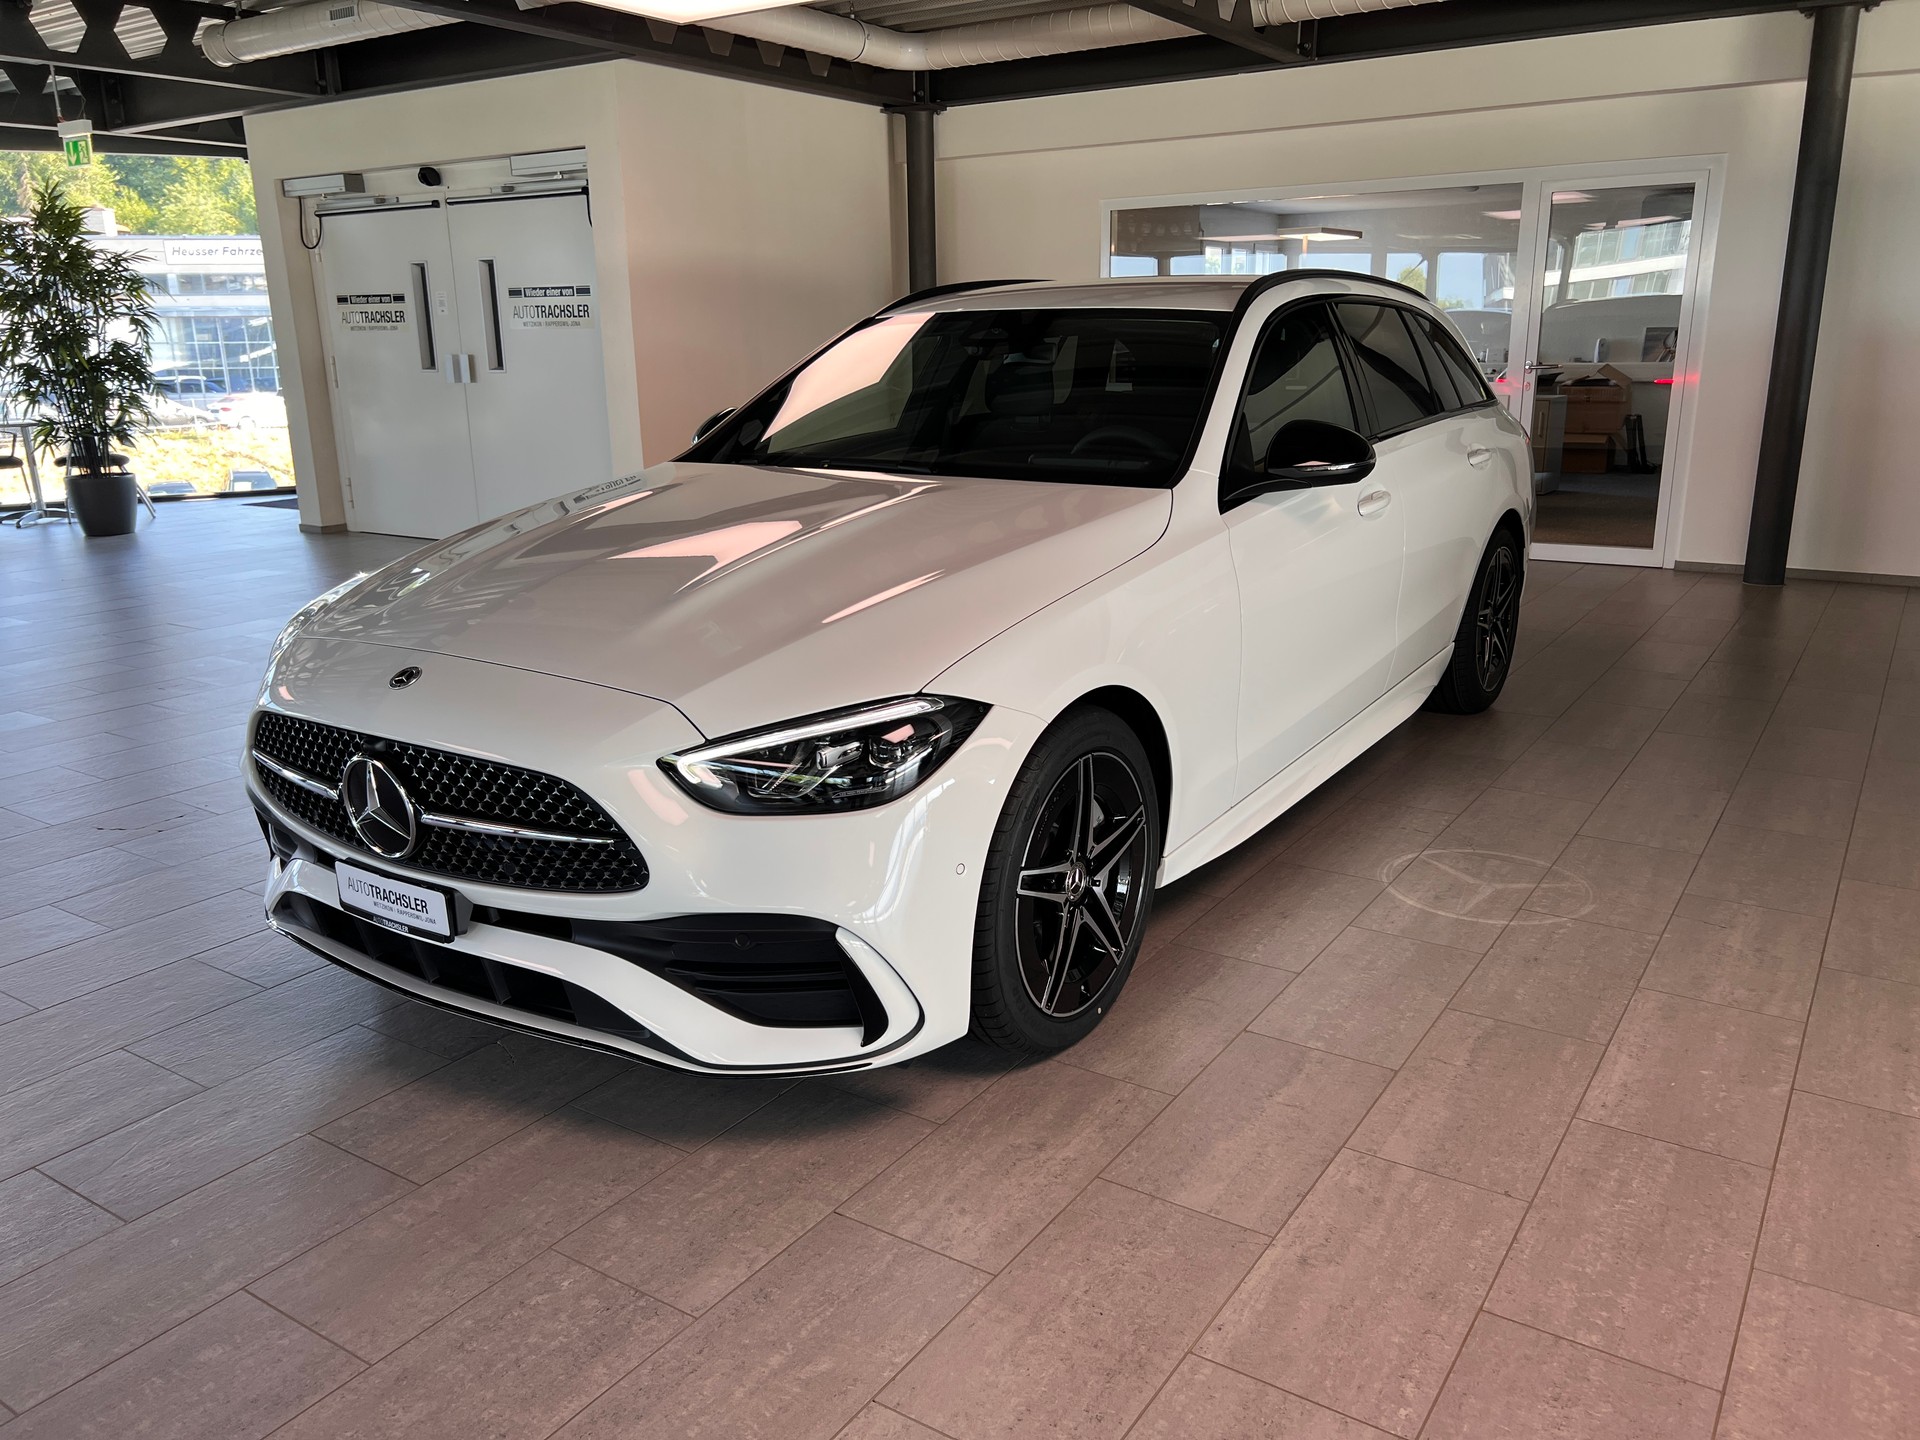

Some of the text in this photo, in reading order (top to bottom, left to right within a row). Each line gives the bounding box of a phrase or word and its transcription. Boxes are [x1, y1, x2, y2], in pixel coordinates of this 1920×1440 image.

[171, 246, 219, 256] Heusser
[525, 287, 574, 297] Wieder einer von
[342, 310, 406, 324] AUTOTRACHSLER
[513, 304, 590, 319] AUTOTRACHSLER
[347, 876, 429, 915] AUTOTRACHSLER
